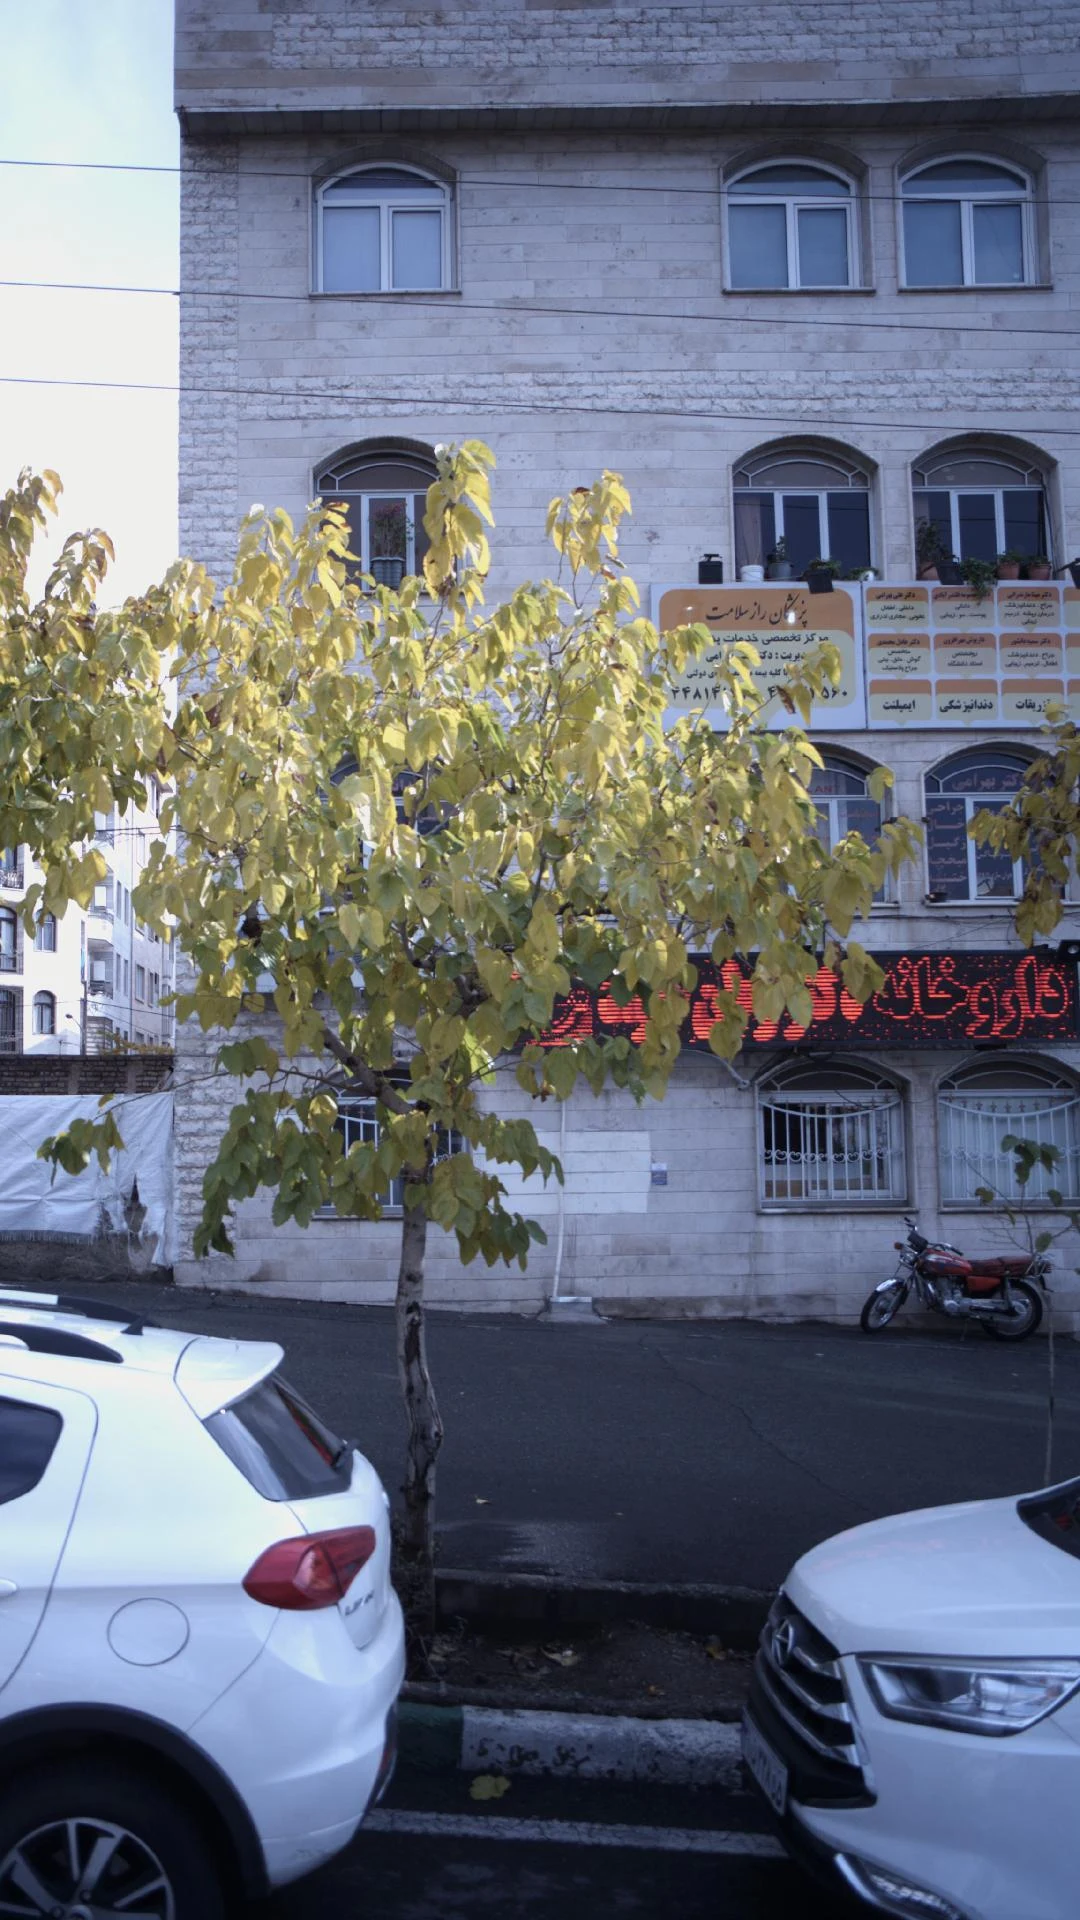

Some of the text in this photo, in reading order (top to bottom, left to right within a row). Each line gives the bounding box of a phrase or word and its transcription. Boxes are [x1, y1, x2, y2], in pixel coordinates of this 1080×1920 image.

[705, 604, 749, 621] سلامت
[749, 601, 767, 620] راز
[723, 633, 759, 642] خدمات
[762, 633, 801, 646] تخصصی
[803, 632, 829, 645] مرکز
[873, 955, 1069, 1039] داروخانه
